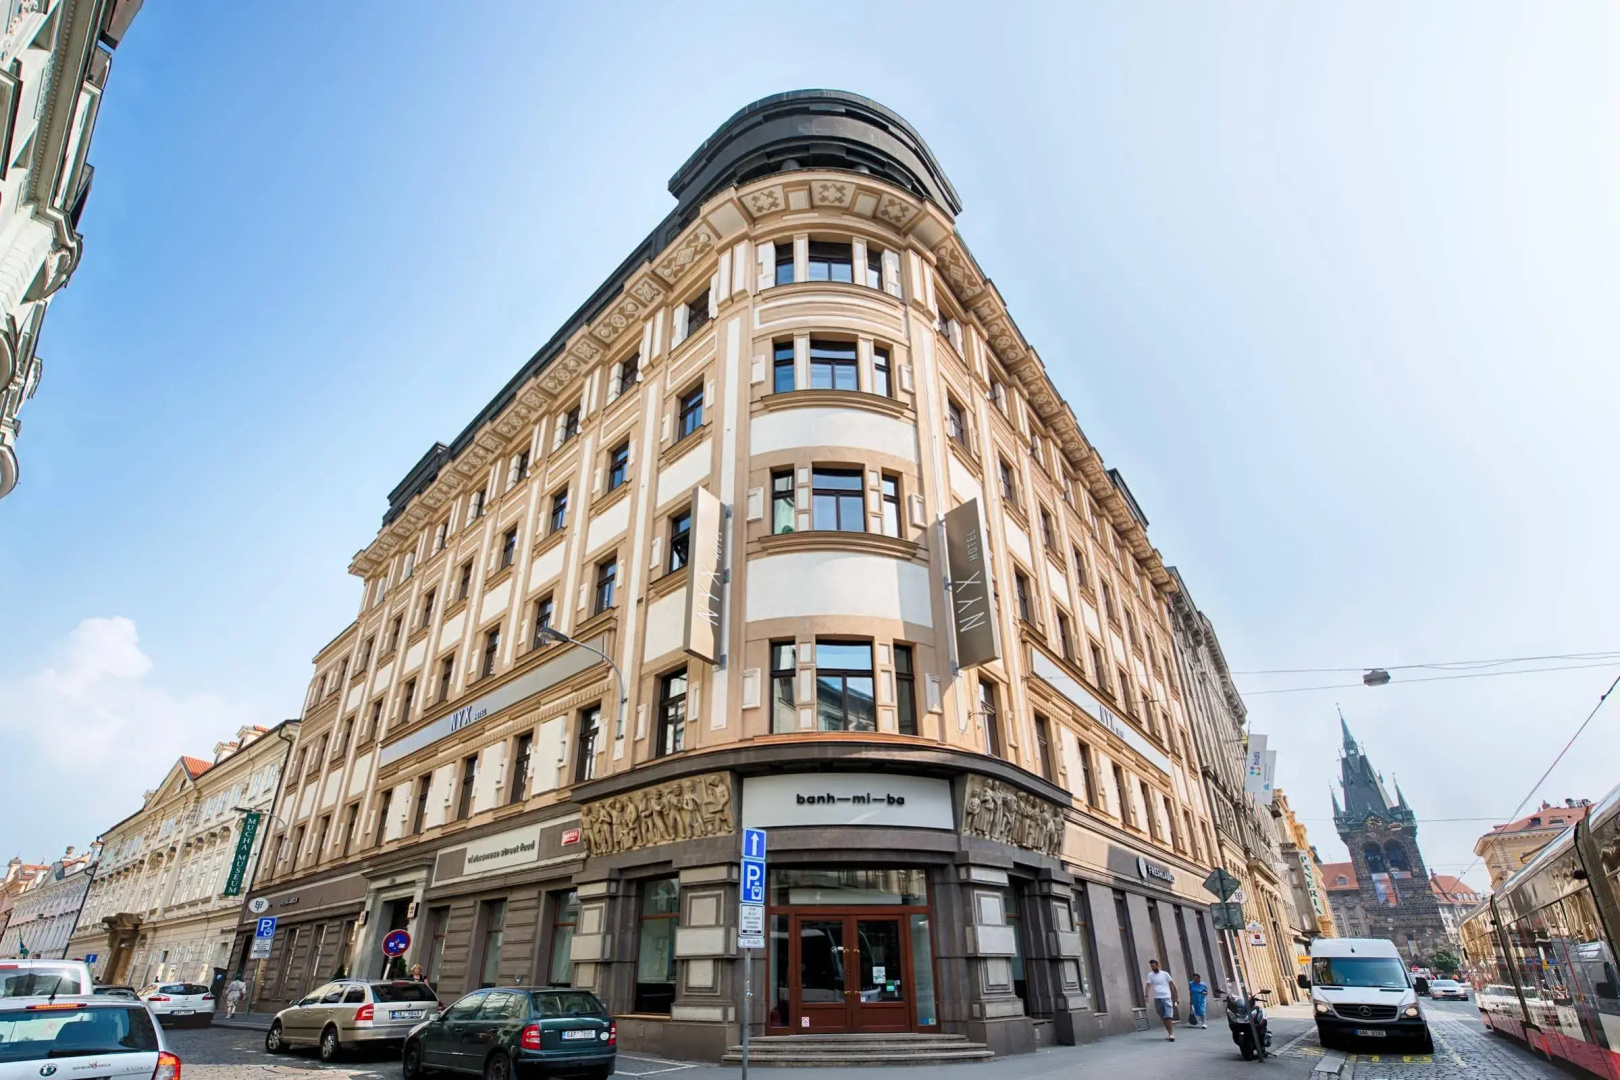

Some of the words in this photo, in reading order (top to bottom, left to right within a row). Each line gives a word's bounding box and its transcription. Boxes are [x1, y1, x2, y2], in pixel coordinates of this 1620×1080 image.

[966, 529, 979, 561] HOTEL
[697, 561, 721, 627] NYX
[955, 570, 986, 632] NYX
[451, 705, 472, 731] NYX
[241, 818, 257, 850] MUCHA
[501, 845, 519, 857] street
[520, 839, 536, 852] food
[228, 854, 246, 893] MUSEUM
[746, 864, 760, 889] P
[260, 919, 273, 931] P
